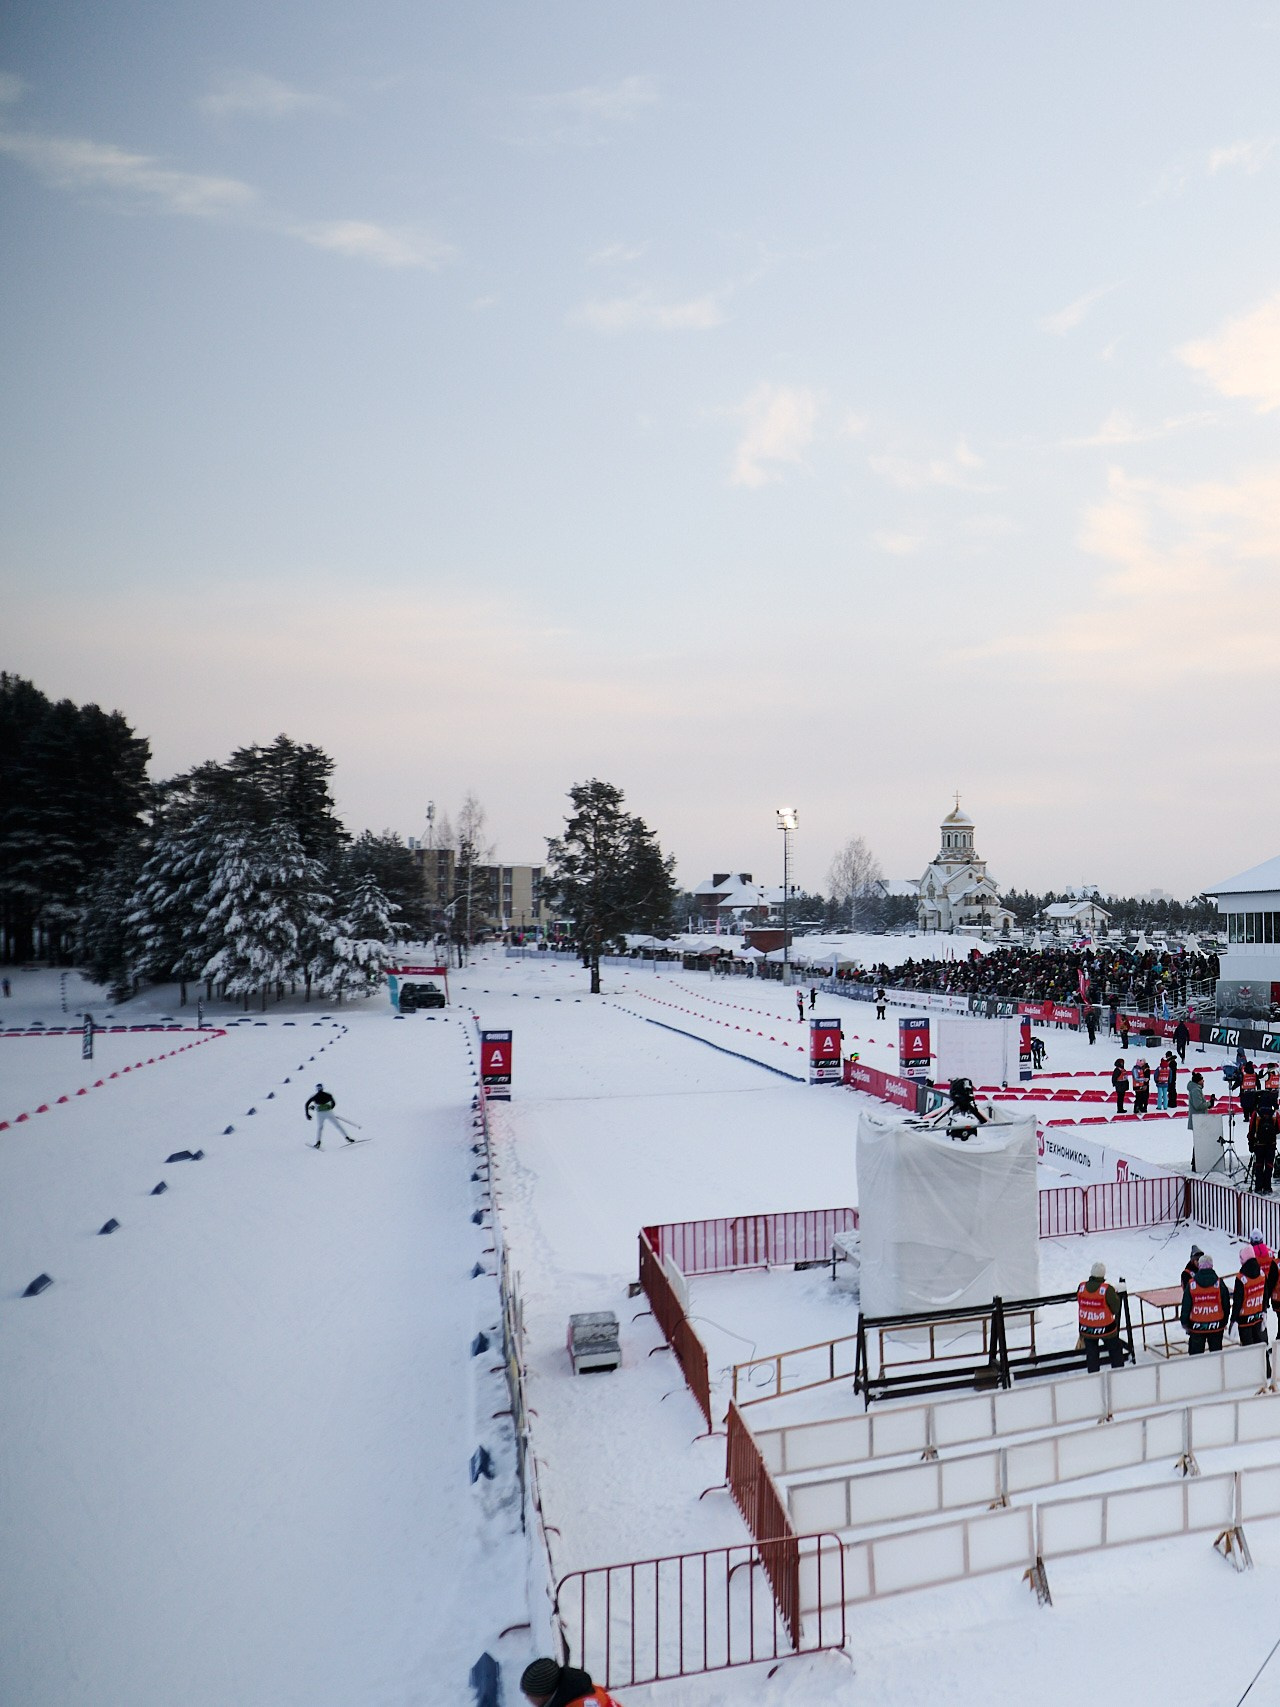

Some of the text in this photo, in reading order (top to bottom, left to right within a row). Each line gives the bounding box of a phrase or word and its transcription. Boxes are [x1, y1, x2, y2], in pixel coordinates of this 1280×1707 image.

[996, 1002, 1014, 1014] PARI
[909, 1019, 926, 1028] СТАРТ
[1209, 1027, 1240, 1046] PARI
[1046, 1140, 1091, 1168] ТЕХНОНИКОЛЬ
[1079, 1309, 1106, 1322] СУДЬЯ
